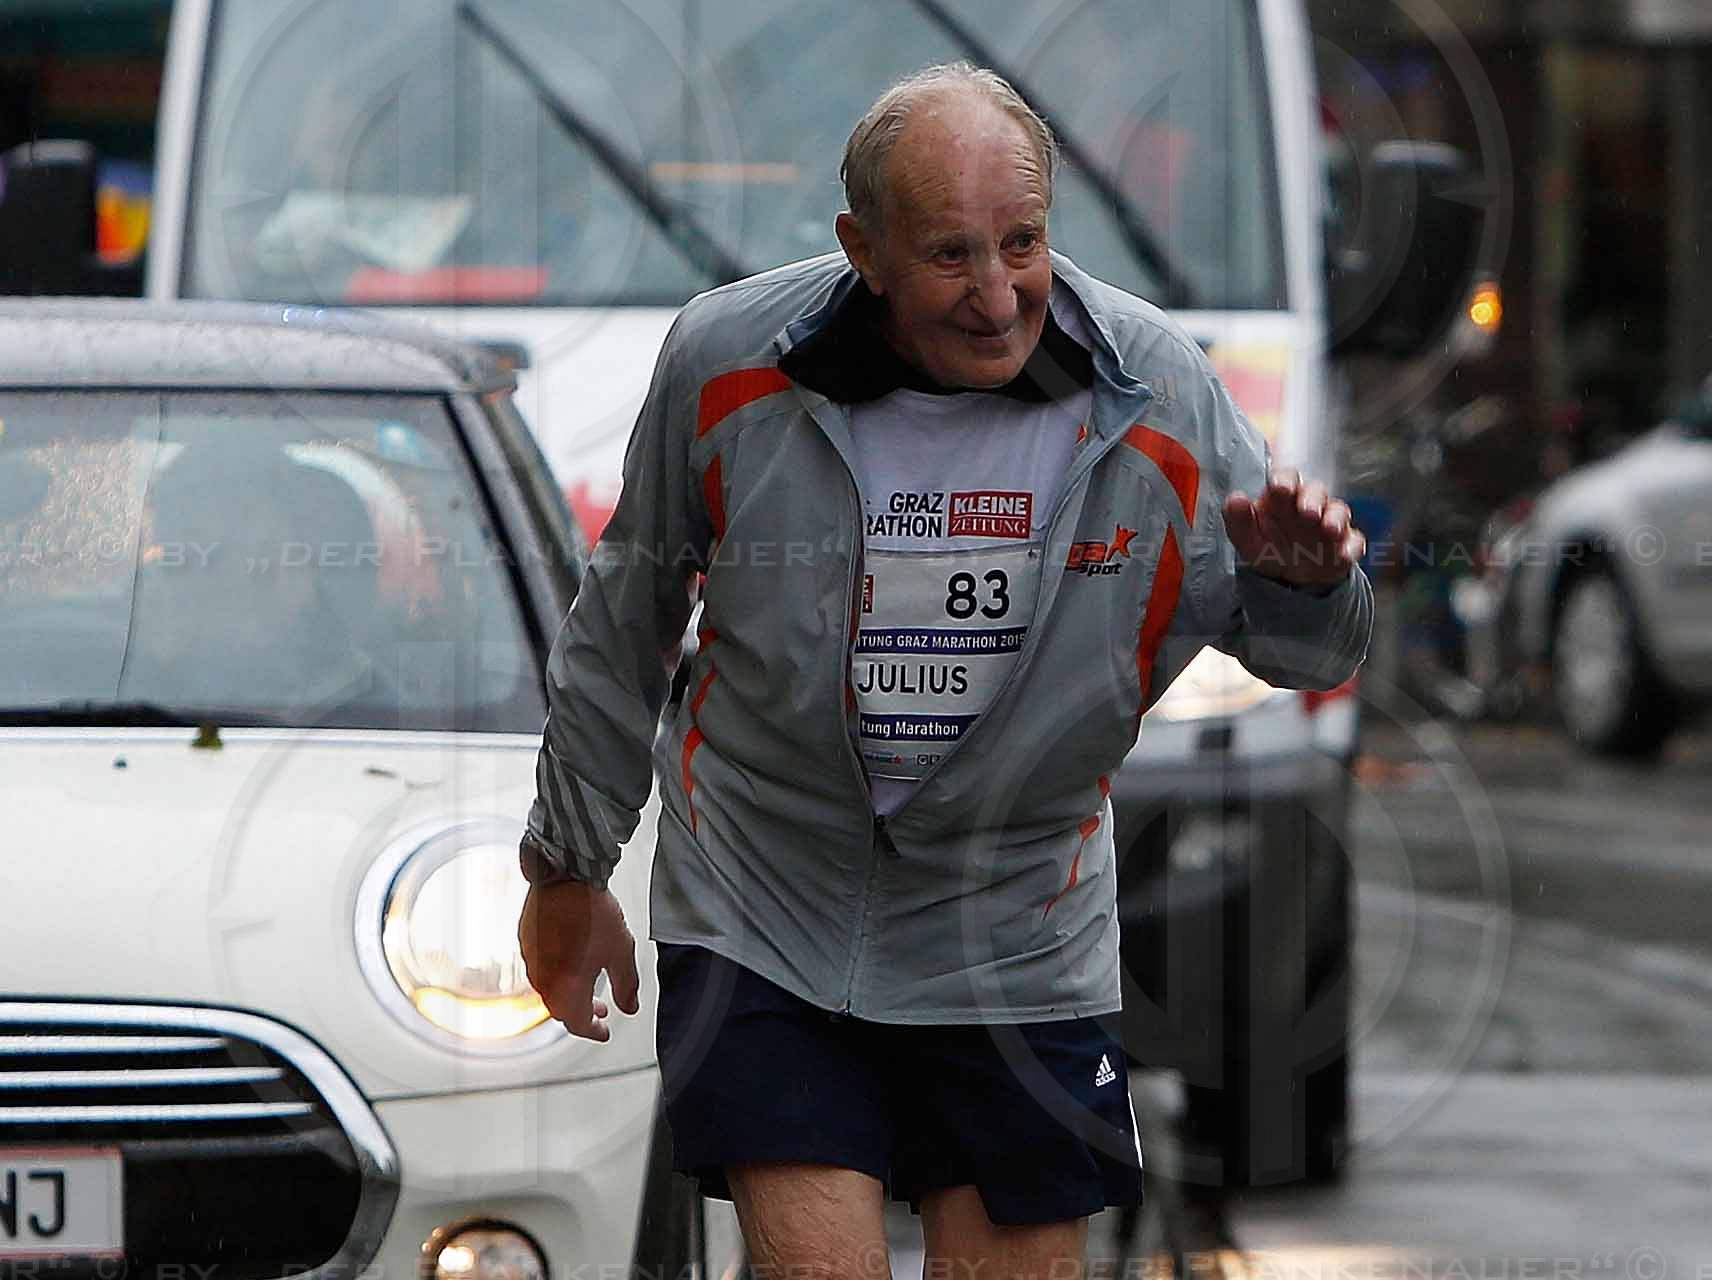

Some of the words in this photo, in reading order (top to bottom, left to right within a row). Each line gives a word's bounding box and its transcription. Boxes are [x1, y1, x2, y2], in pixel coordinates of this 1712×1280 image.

[888, 491, 944, 514] GRAZ
[953, 496, 1028, 516] KLEINE
[951, 516, 1027, 534] ZEITUNG
[945, 570, 1010, 620] 83
[896, 634, 928, 649] GRAZ
[931, 634, 997, 649] MARATHON
[857, 663, 969, 695] JULIUS
[895, 721, 959, 736] Marathon
